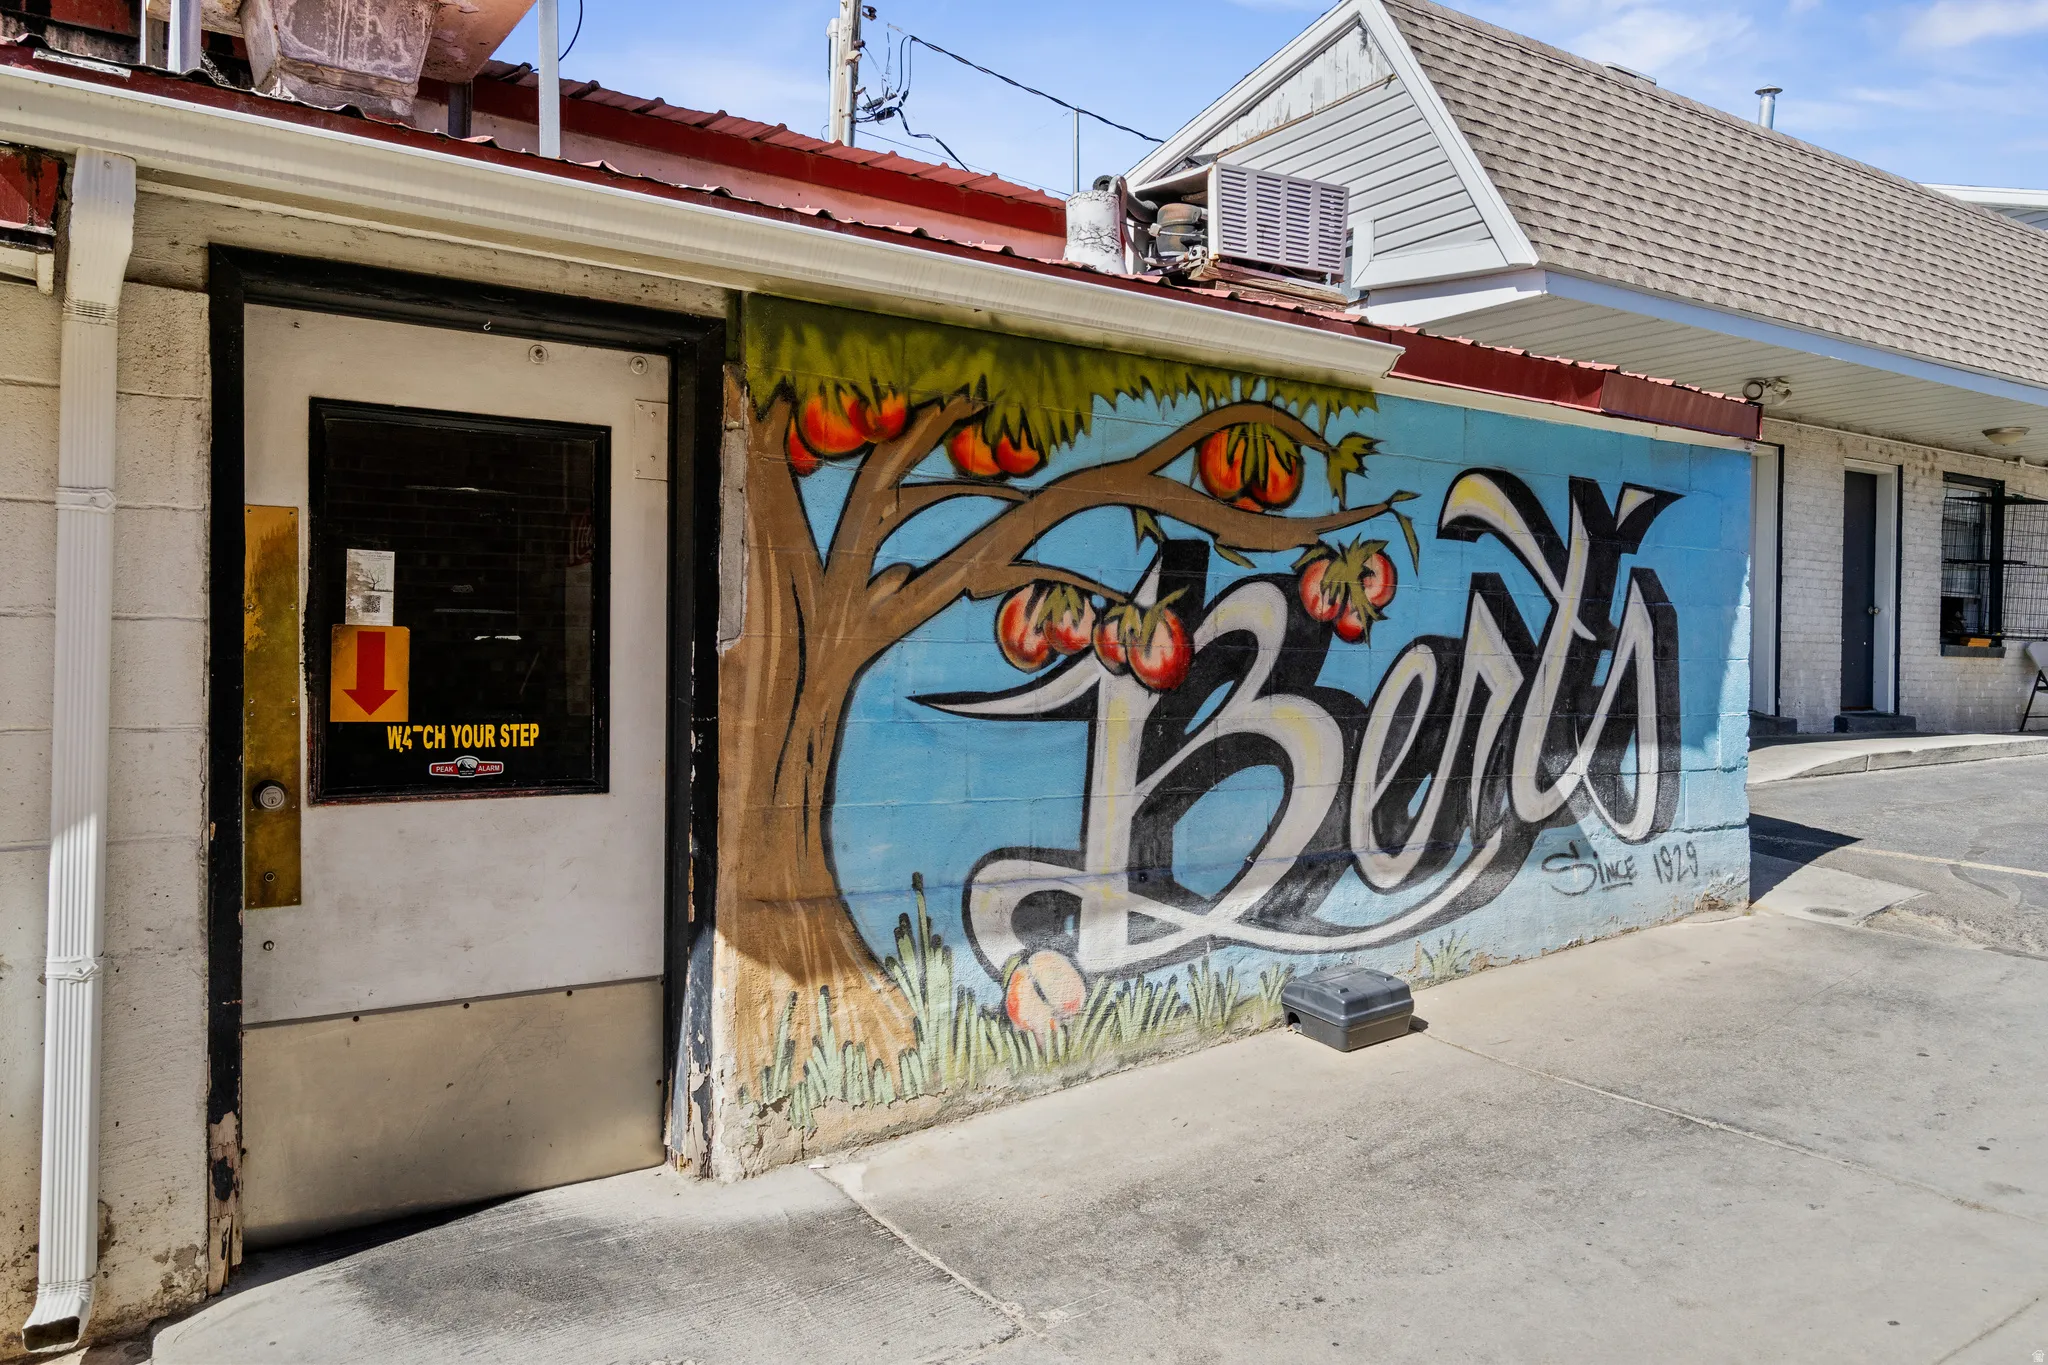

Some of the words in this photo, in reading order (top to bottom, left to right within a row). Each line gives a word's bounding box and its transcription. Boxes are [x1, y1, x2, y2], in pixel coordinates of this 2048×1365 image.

[451, 723, 496, 749] YOUR
[500, 723, 540, 748] STEP
[436, 765, 454, 773] PEAK
[1652, 840, 1700, 884] 1929
